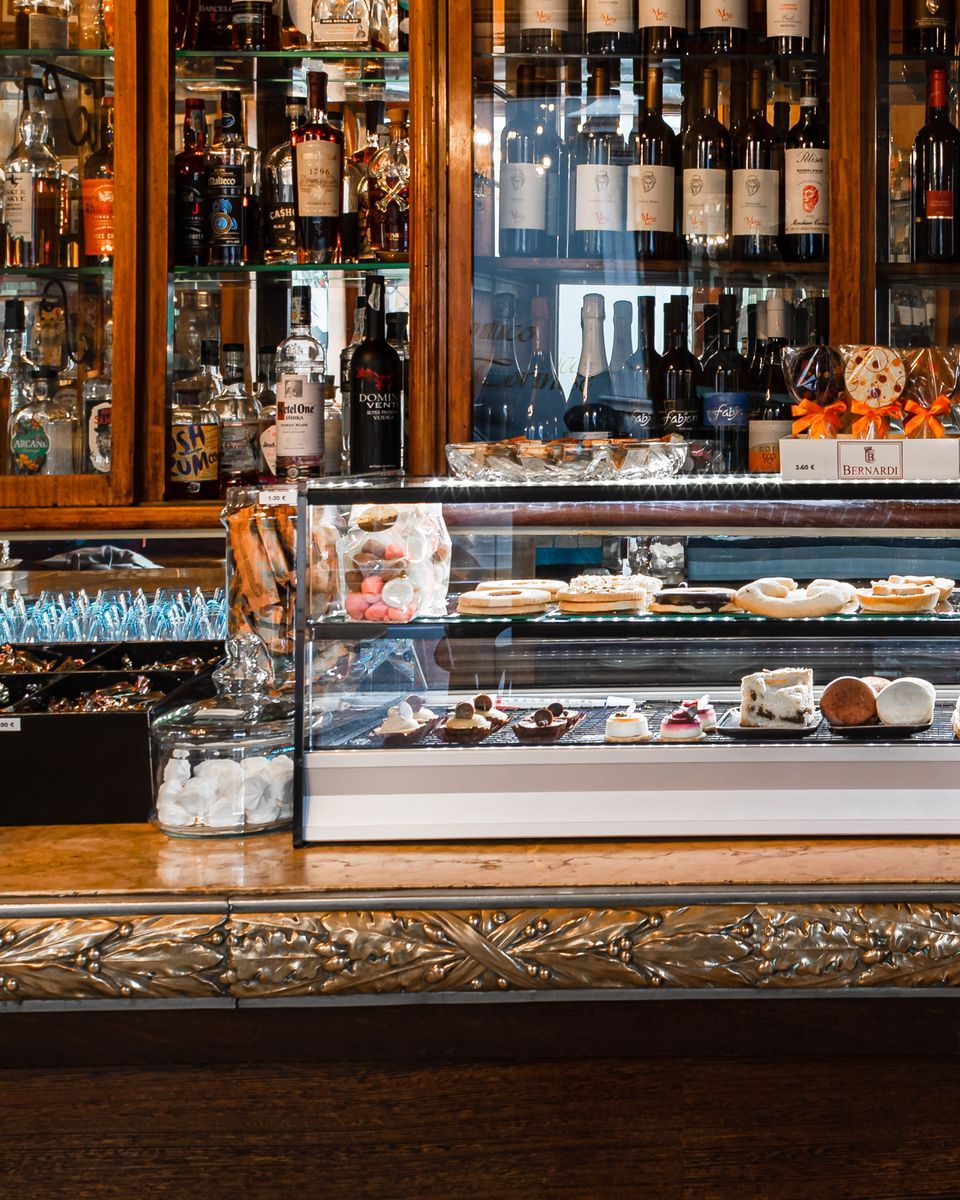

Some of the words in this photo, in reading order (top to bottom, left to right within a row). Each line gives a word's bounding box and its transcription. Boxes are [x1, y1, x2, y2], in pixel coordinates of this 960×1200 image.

[309, 168, 330, 176] 1796
[298, 403, 314, 414] One
[843, 465, 898, 476] BERNARDI
